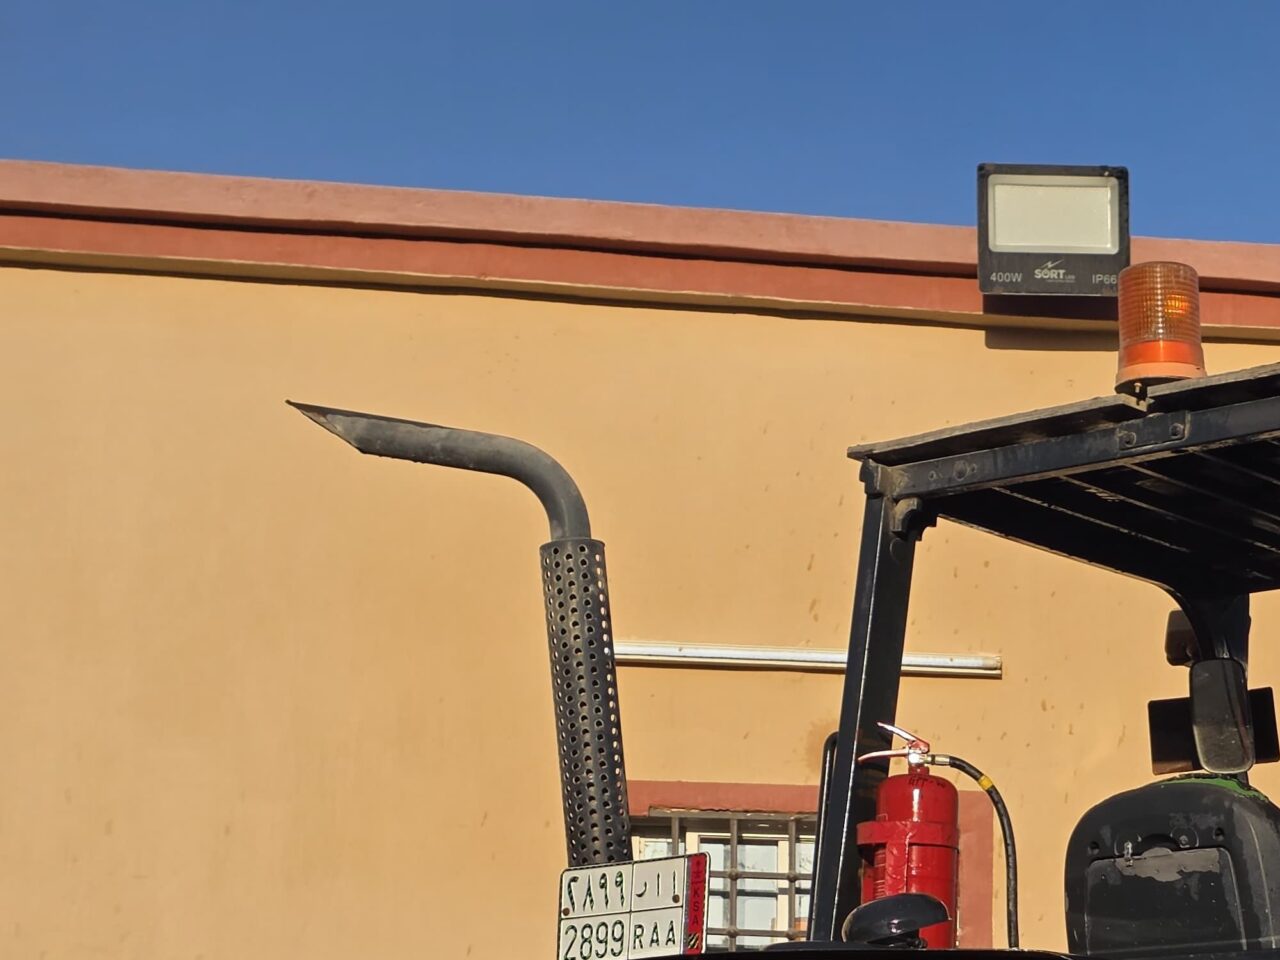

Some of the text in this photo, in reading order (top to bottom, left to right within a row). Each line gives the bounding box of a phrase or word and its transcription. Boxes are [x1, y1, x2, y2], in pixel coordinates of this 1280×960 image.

[989, 272, 1023, 283] 400W
[1034, 268, 1066, 279] SORT
[1092, 274, 1117, 285] IP66
[633, 920, 677, 950] RAA
